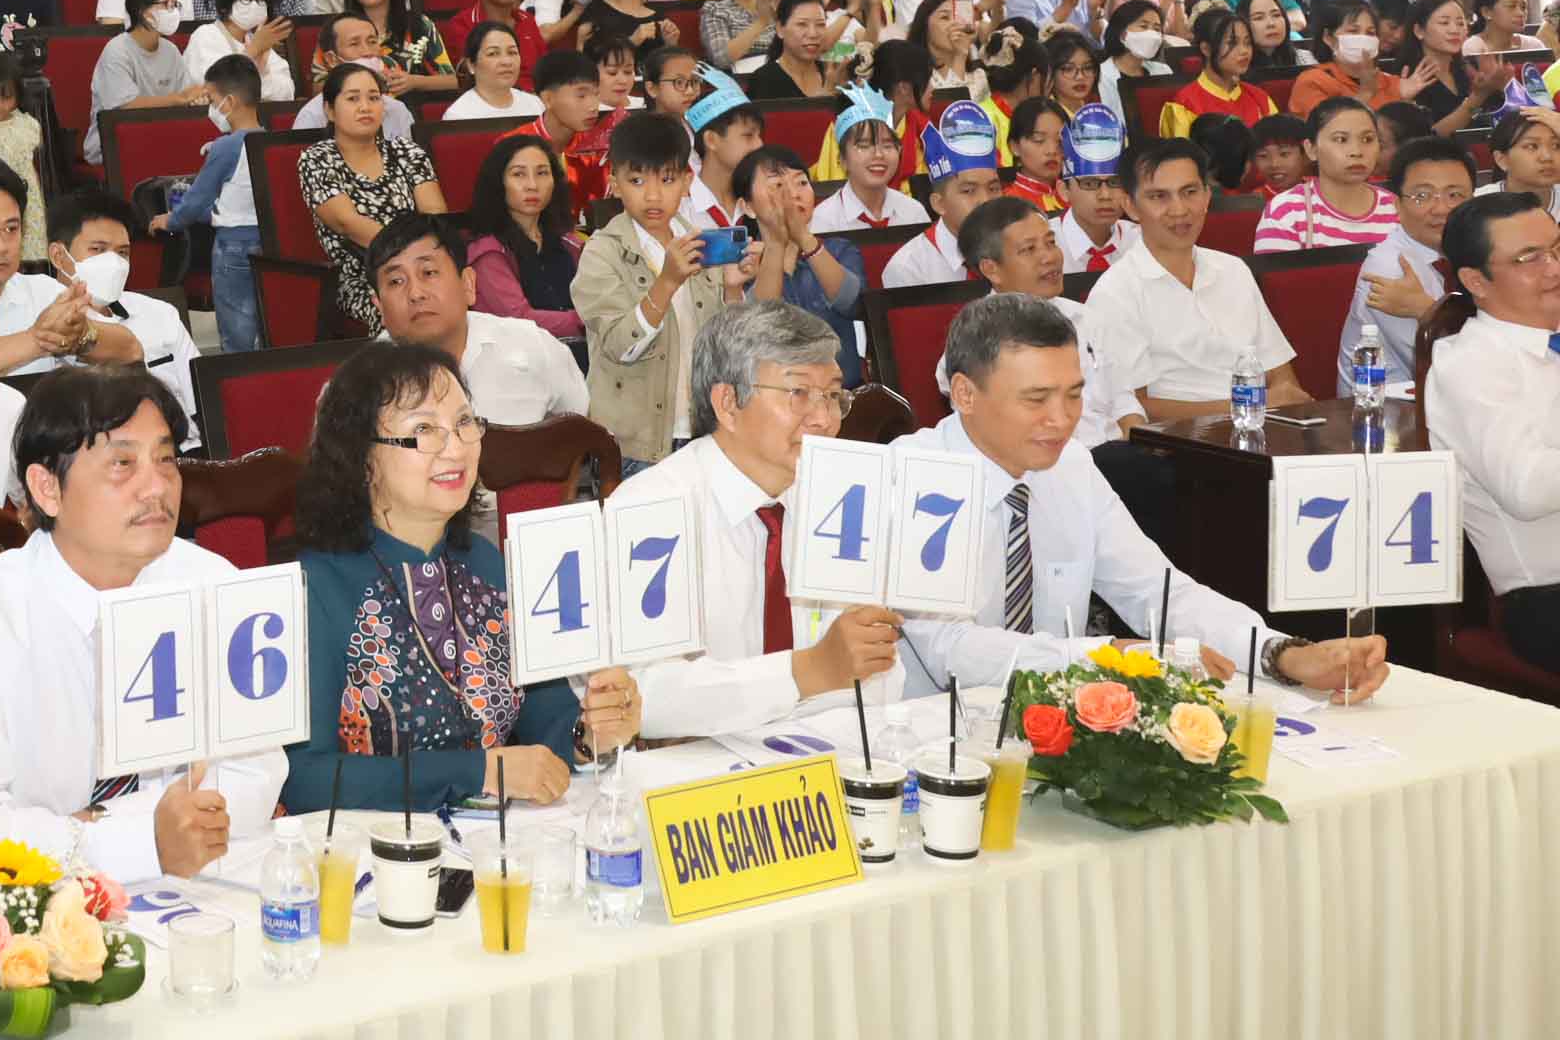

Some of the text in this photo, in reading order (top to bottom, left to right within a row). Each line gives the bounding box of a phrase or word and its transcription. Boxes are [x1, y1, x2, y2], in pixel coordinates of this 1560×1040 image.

[666, 775, 837, 884] BAN GIÁM KHẢO
